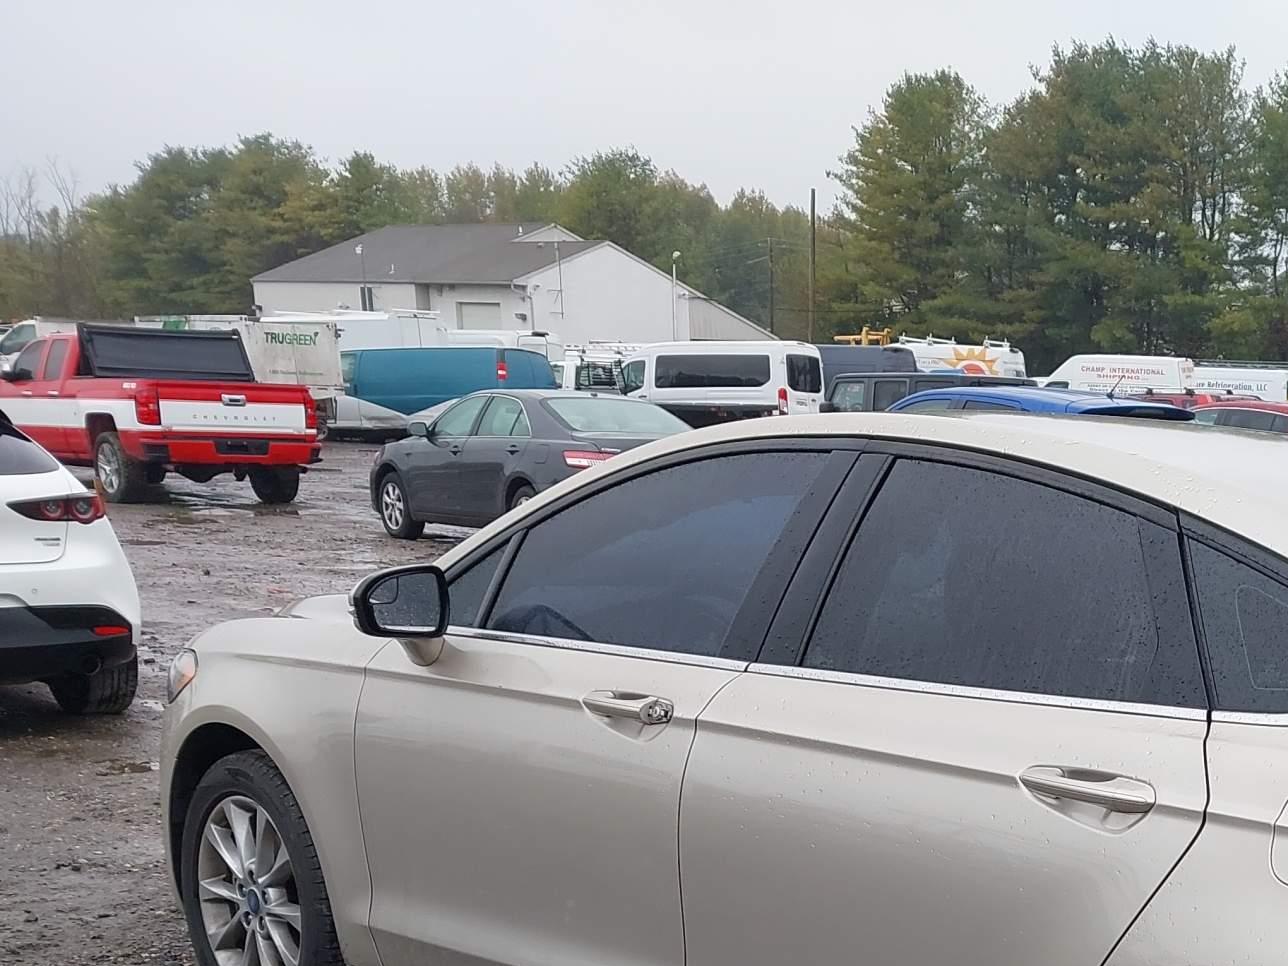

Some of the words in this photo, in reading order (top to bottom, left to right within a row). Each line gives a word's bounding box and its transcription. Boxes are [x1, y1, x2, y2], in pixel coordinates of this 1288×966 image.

[264, 331, 317, 346] TRUGREEN
[1081, 366, 1105, 374] CHAMP
[1109, 367, 1165, 376] INTERNATIONAL
